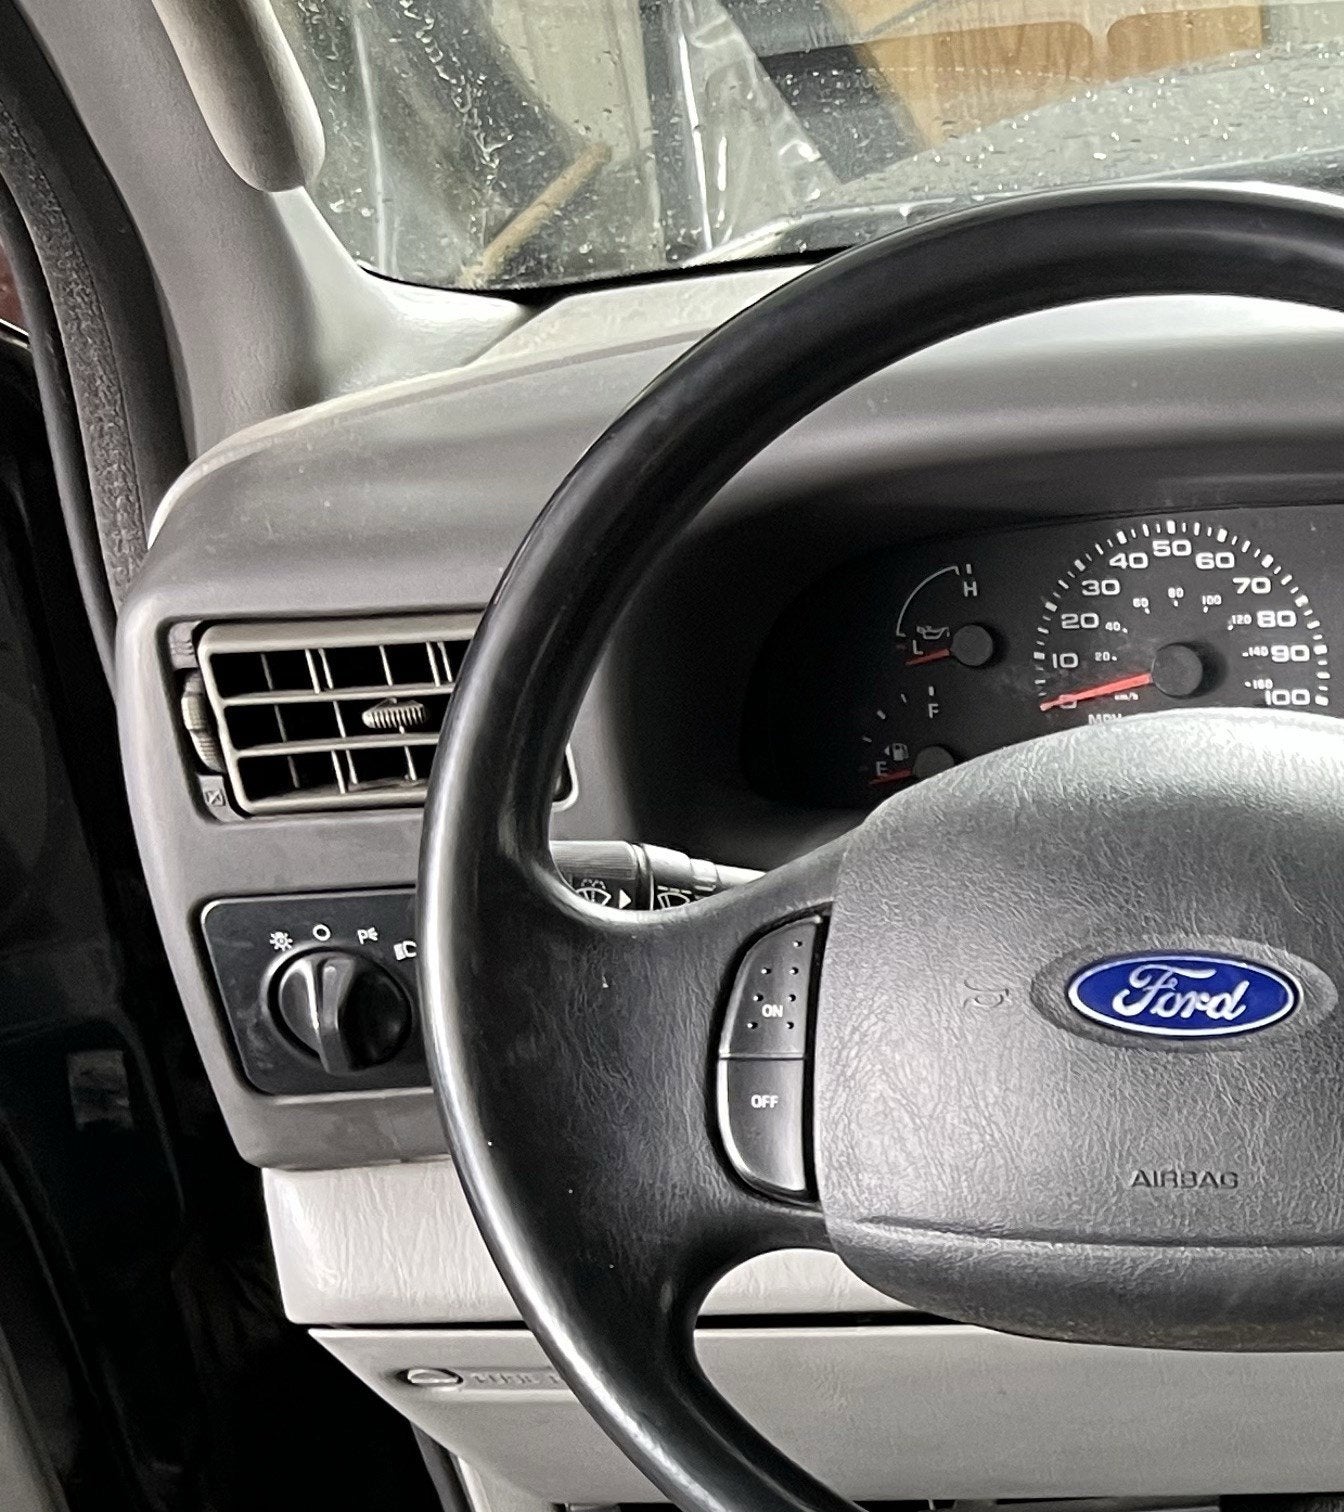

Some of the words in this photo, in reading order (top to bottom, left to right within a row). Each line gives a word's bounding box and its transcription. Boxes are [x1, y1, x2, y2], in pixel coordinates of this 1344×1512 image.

[1152, 539, 1192, 557] 50
[1109, 552, 1148, 569] 40
[1195, 551, 1235, 569] 60
[963, 581, 977, 597] H
[1081, 579, 1121, 596] 30
[1232, 577, 1272, 594] 70
[1061, 612, 1099, 629] 20
[1105, 621, 1121, 632] 40
[1231, 614, 1251, 625] 120
[1256, 610, 1297, 629] 80
[913, 639, 923, 655] L
[1270, 645, 1310, 662] 90
[1052, 652, 1079, 669] 10
[1264, 689, 1310, 706] 100
[928, 703, 939, 718] F
[876, 761, 887, 776] E
[1112, 964, 1250, 1021] Ford
[762, 1004, 783, 1018] ON
[750, 1094, 779, 1109] OFF
[1130, 1169, 1240, 1190] AIRBAG
